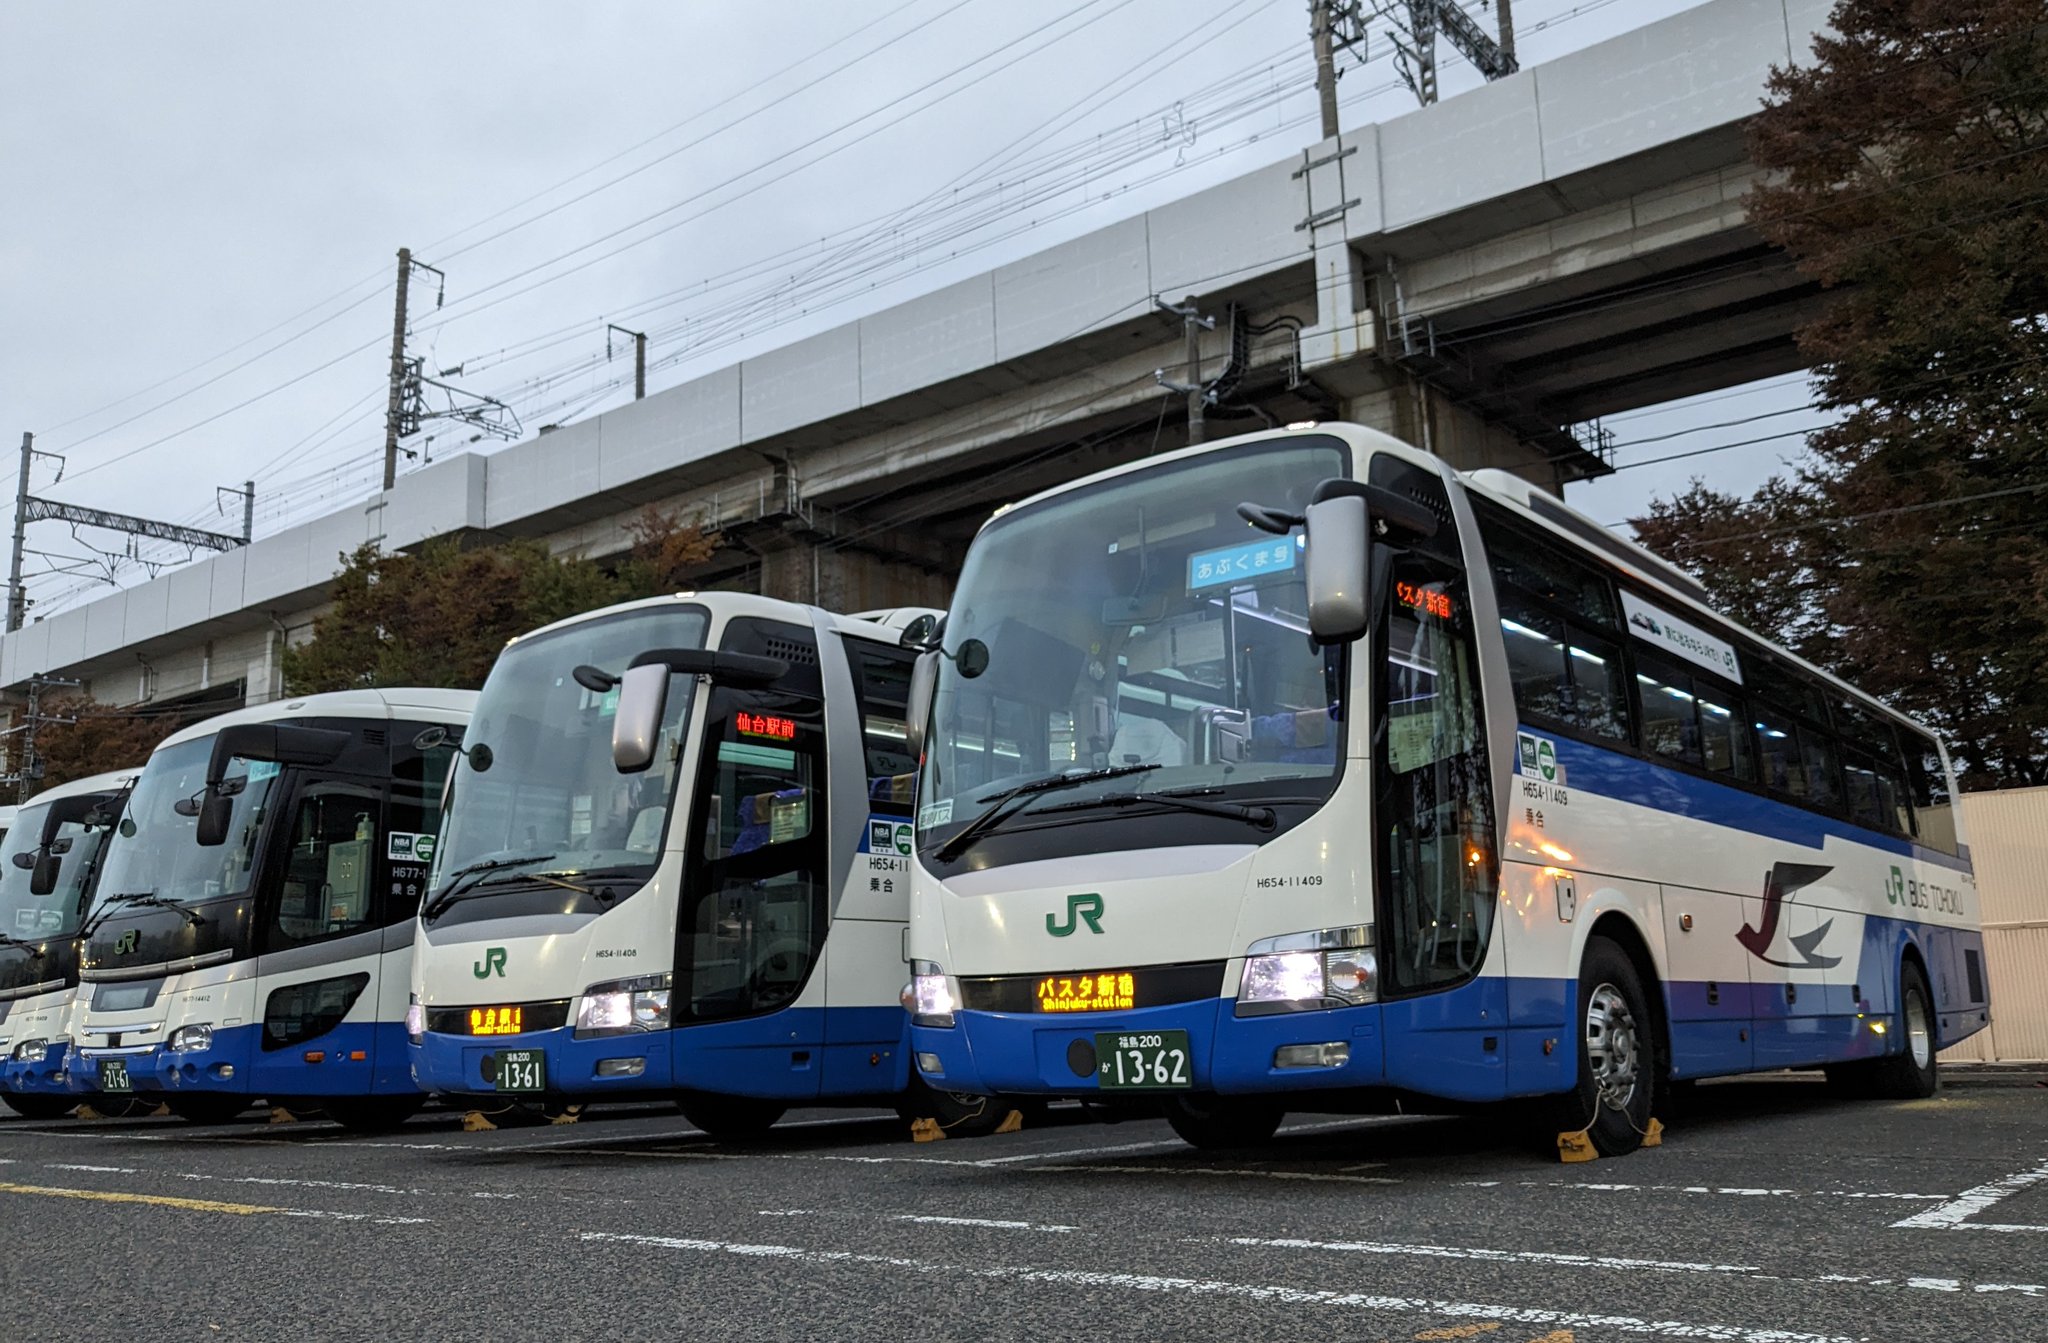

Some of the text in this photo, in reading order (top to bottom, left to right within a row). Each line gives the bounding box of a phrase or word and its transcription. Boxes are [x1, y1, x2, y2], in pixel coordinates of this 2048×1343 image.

[1197, 545, 1289, 579] あぶくま号
[736, 712, 795, 739] 仙台駅前
[1522, 780, 1568, 806] H654-11409
[874, 827, 890, 838] NBA
[392, 866, 427, 879] H677-1
[1256, 875, 1323, 888] H654-11409
[870, 878, 894, 894] 乗合
[1884, 865, 1964, 915] JR BUS TOHOKU
[1045, 892, 1105, 938] JR
[114, 929, 135, 955] JR
[596, 949, 637, 958] H654-11408
[473, 946, 507, 979] JR
[1037, 972, 1134, 998] バスタ新宿
[1042, 995, 1133, 1010] Shinjuku-station
[1101, 1049, 1187, 1084] か 13-62
